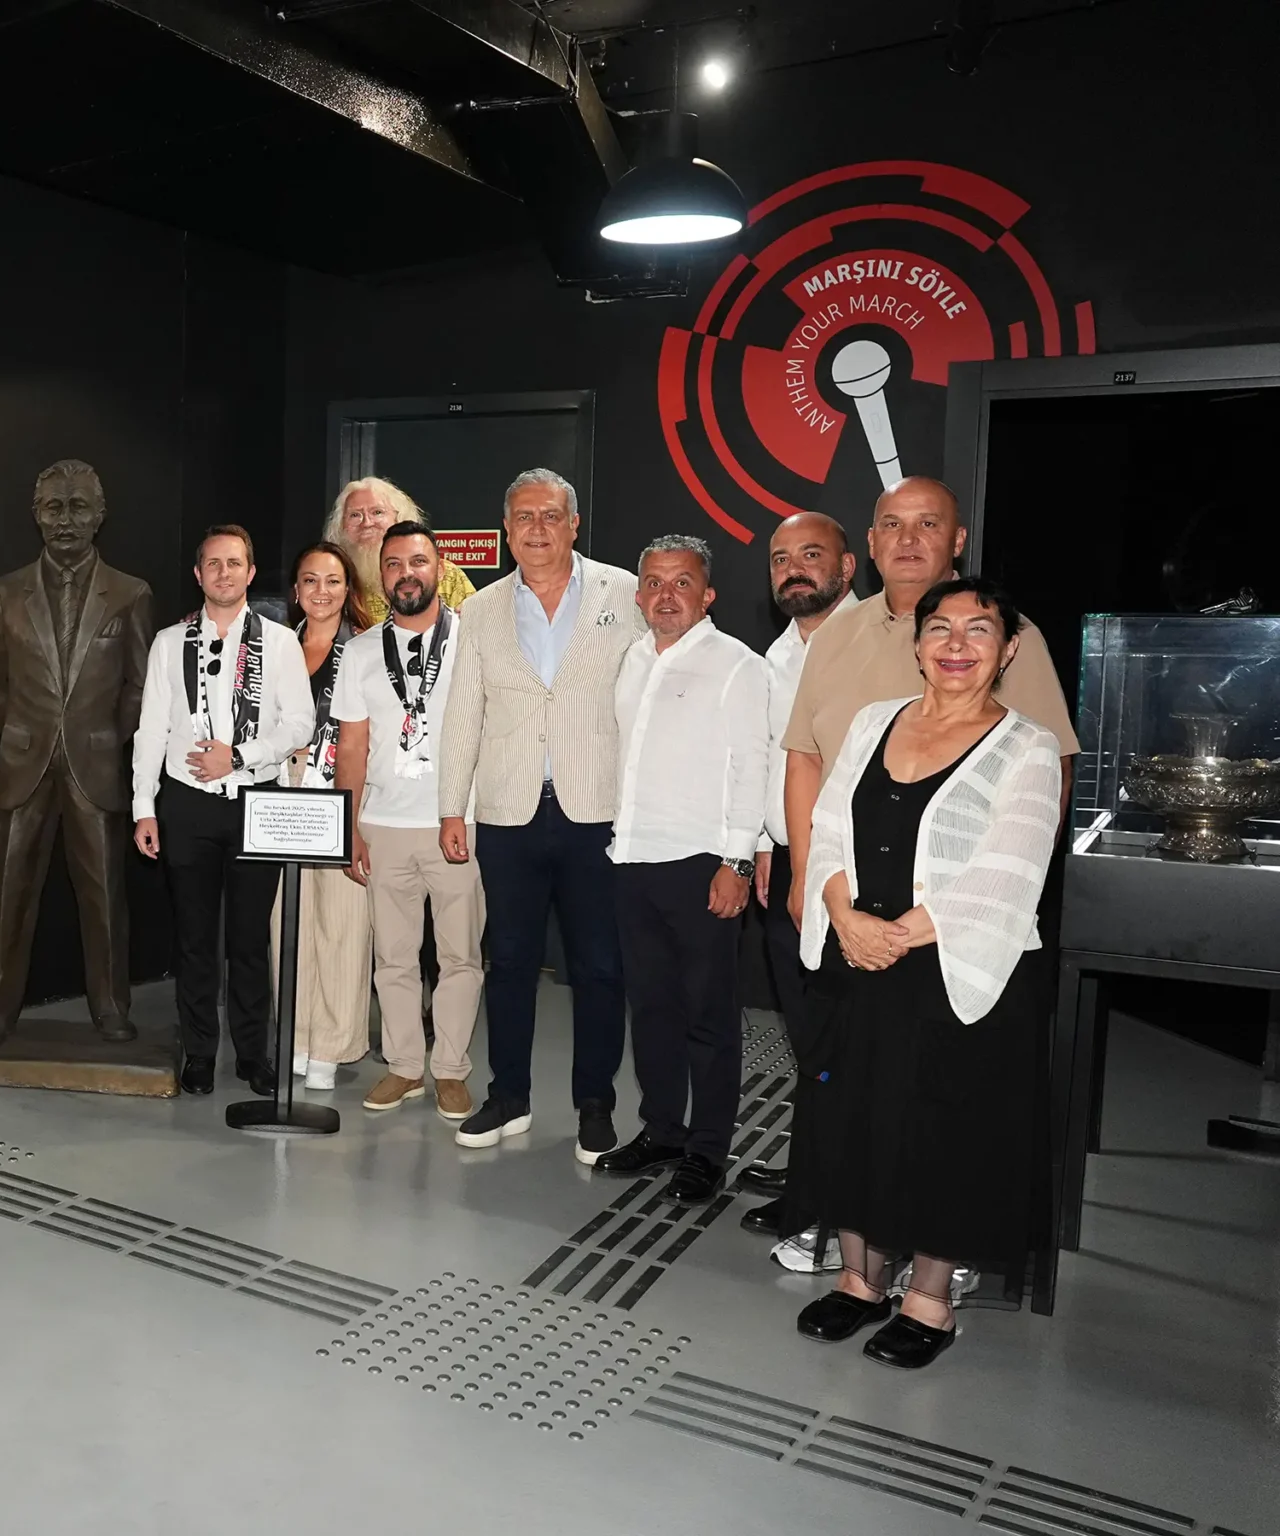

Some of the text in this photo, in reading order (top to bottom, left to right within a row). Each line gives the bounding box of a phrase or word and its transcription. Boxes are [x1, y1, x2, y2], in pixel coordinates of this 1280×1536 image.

[803, 259, 967, 319] MARŞINI SÖYLE
[786, 294, 925, 434] ANTHEM YOUR MARCH
[1115, 374, 1134, 382] 2137
[436, 539, 496, 549] YANGIN ÇIKIŞI
[444, 552, 487, 561] FIRE EXIT
